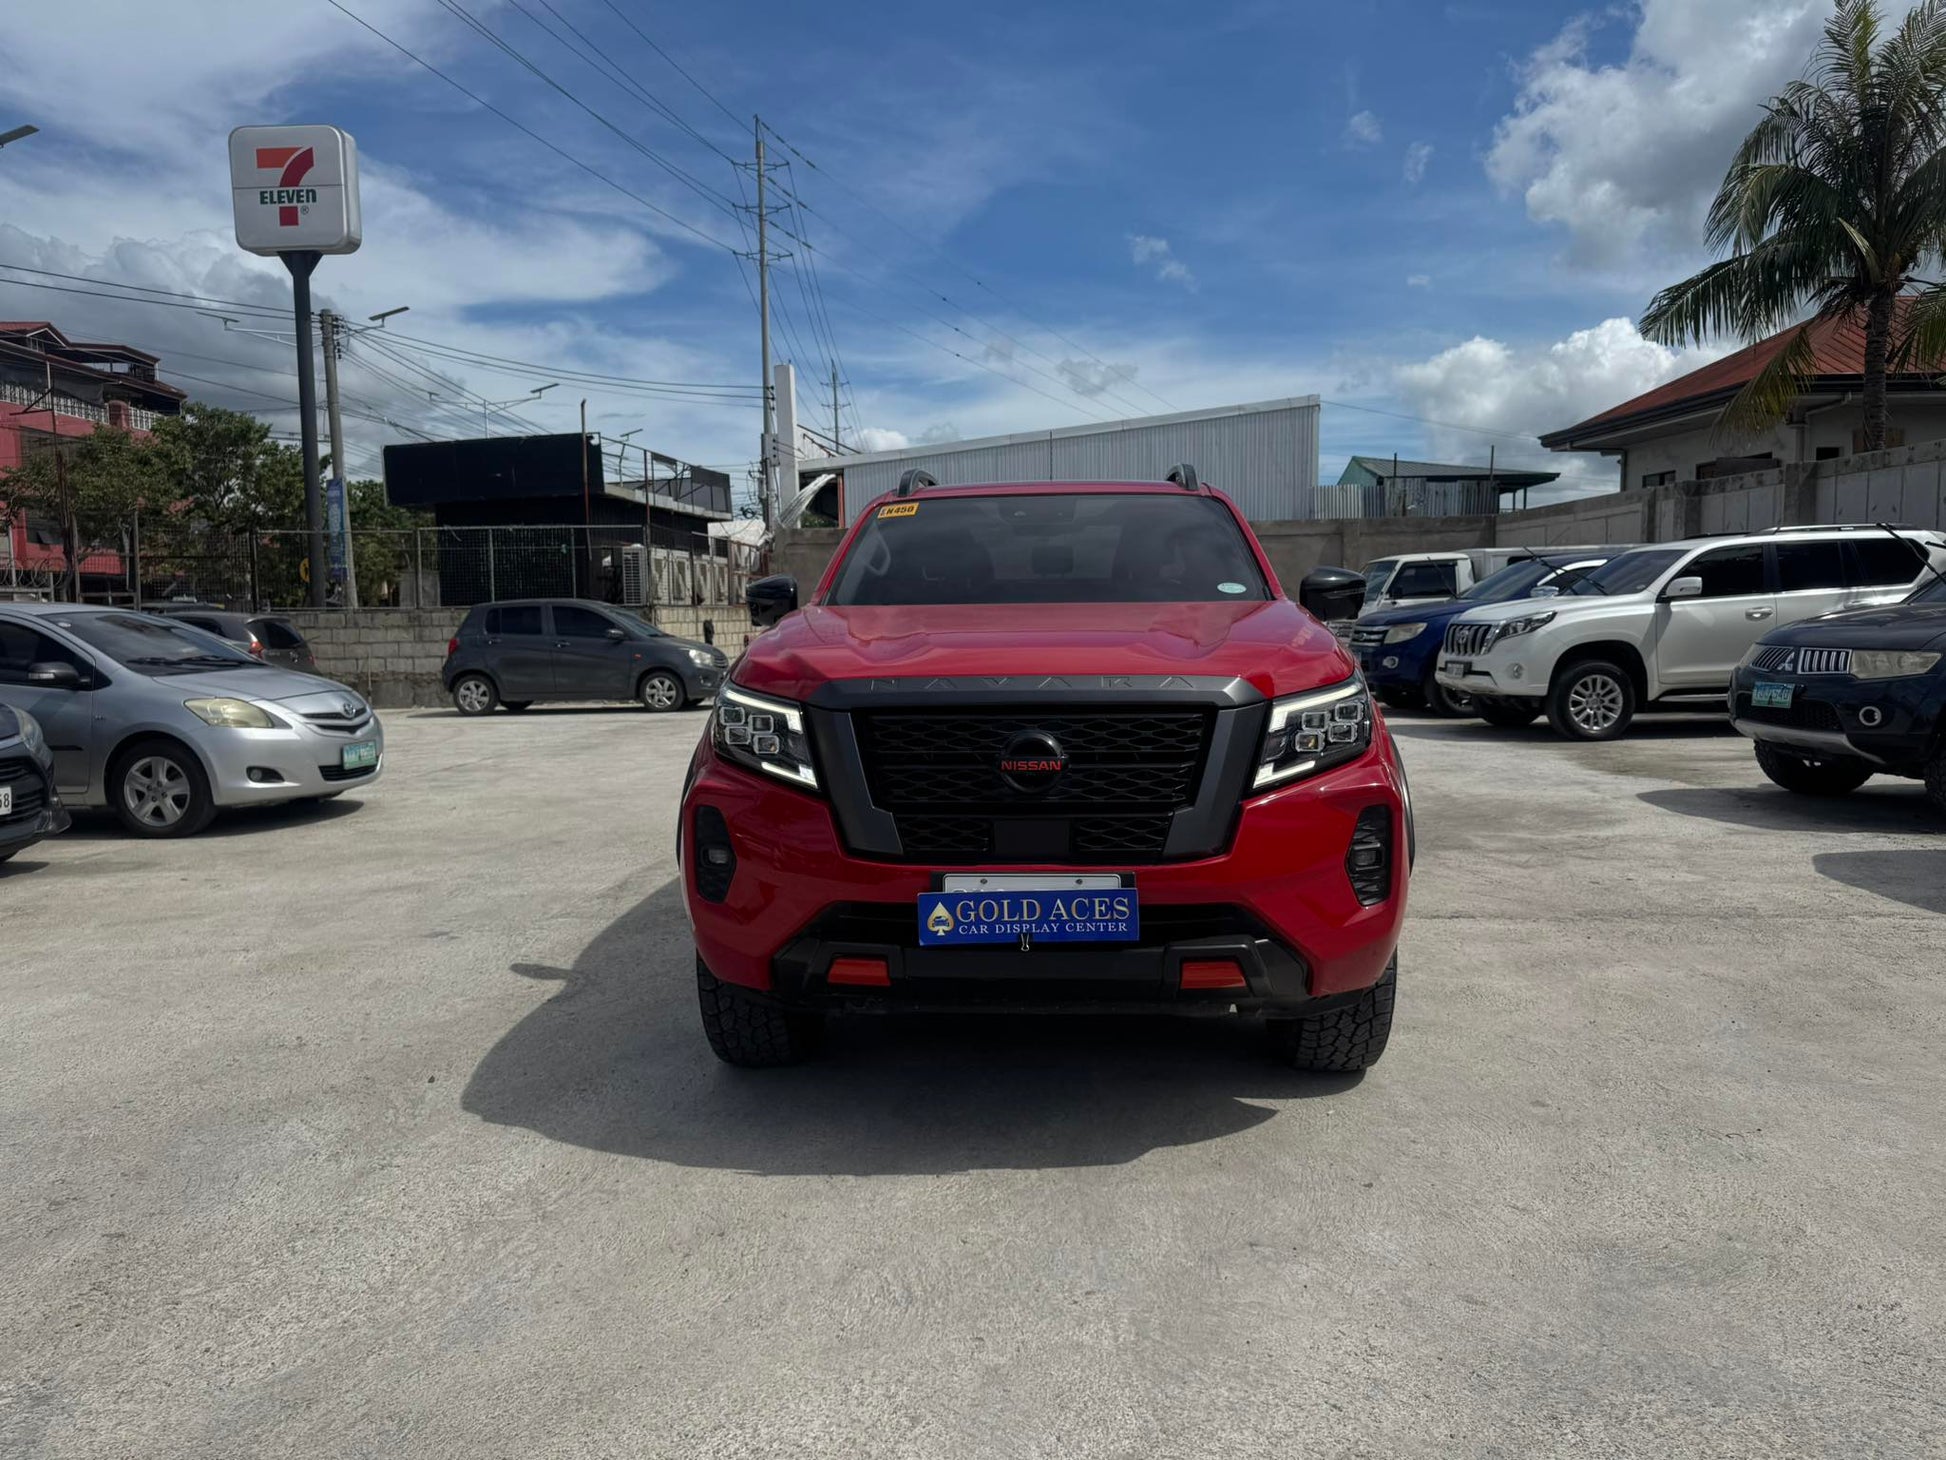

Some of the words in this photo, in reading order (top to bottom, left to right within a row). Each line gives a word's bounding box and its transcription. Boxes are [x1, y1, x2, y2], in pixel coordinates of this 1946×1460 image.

[255, 146, 314, 226] 7
[868, 677, 1195, 691] NAVARA
[1001, 760, 1062, 771] NISSAN
[956, 899, 1041, 922] GOLD
[1048, 897, 1130, 920] ACES
[958, 925, 989, 935] CAR
[995, 923, 1060, 934] DISPLAY
[1065, 922, 1128, 932] CENTER
